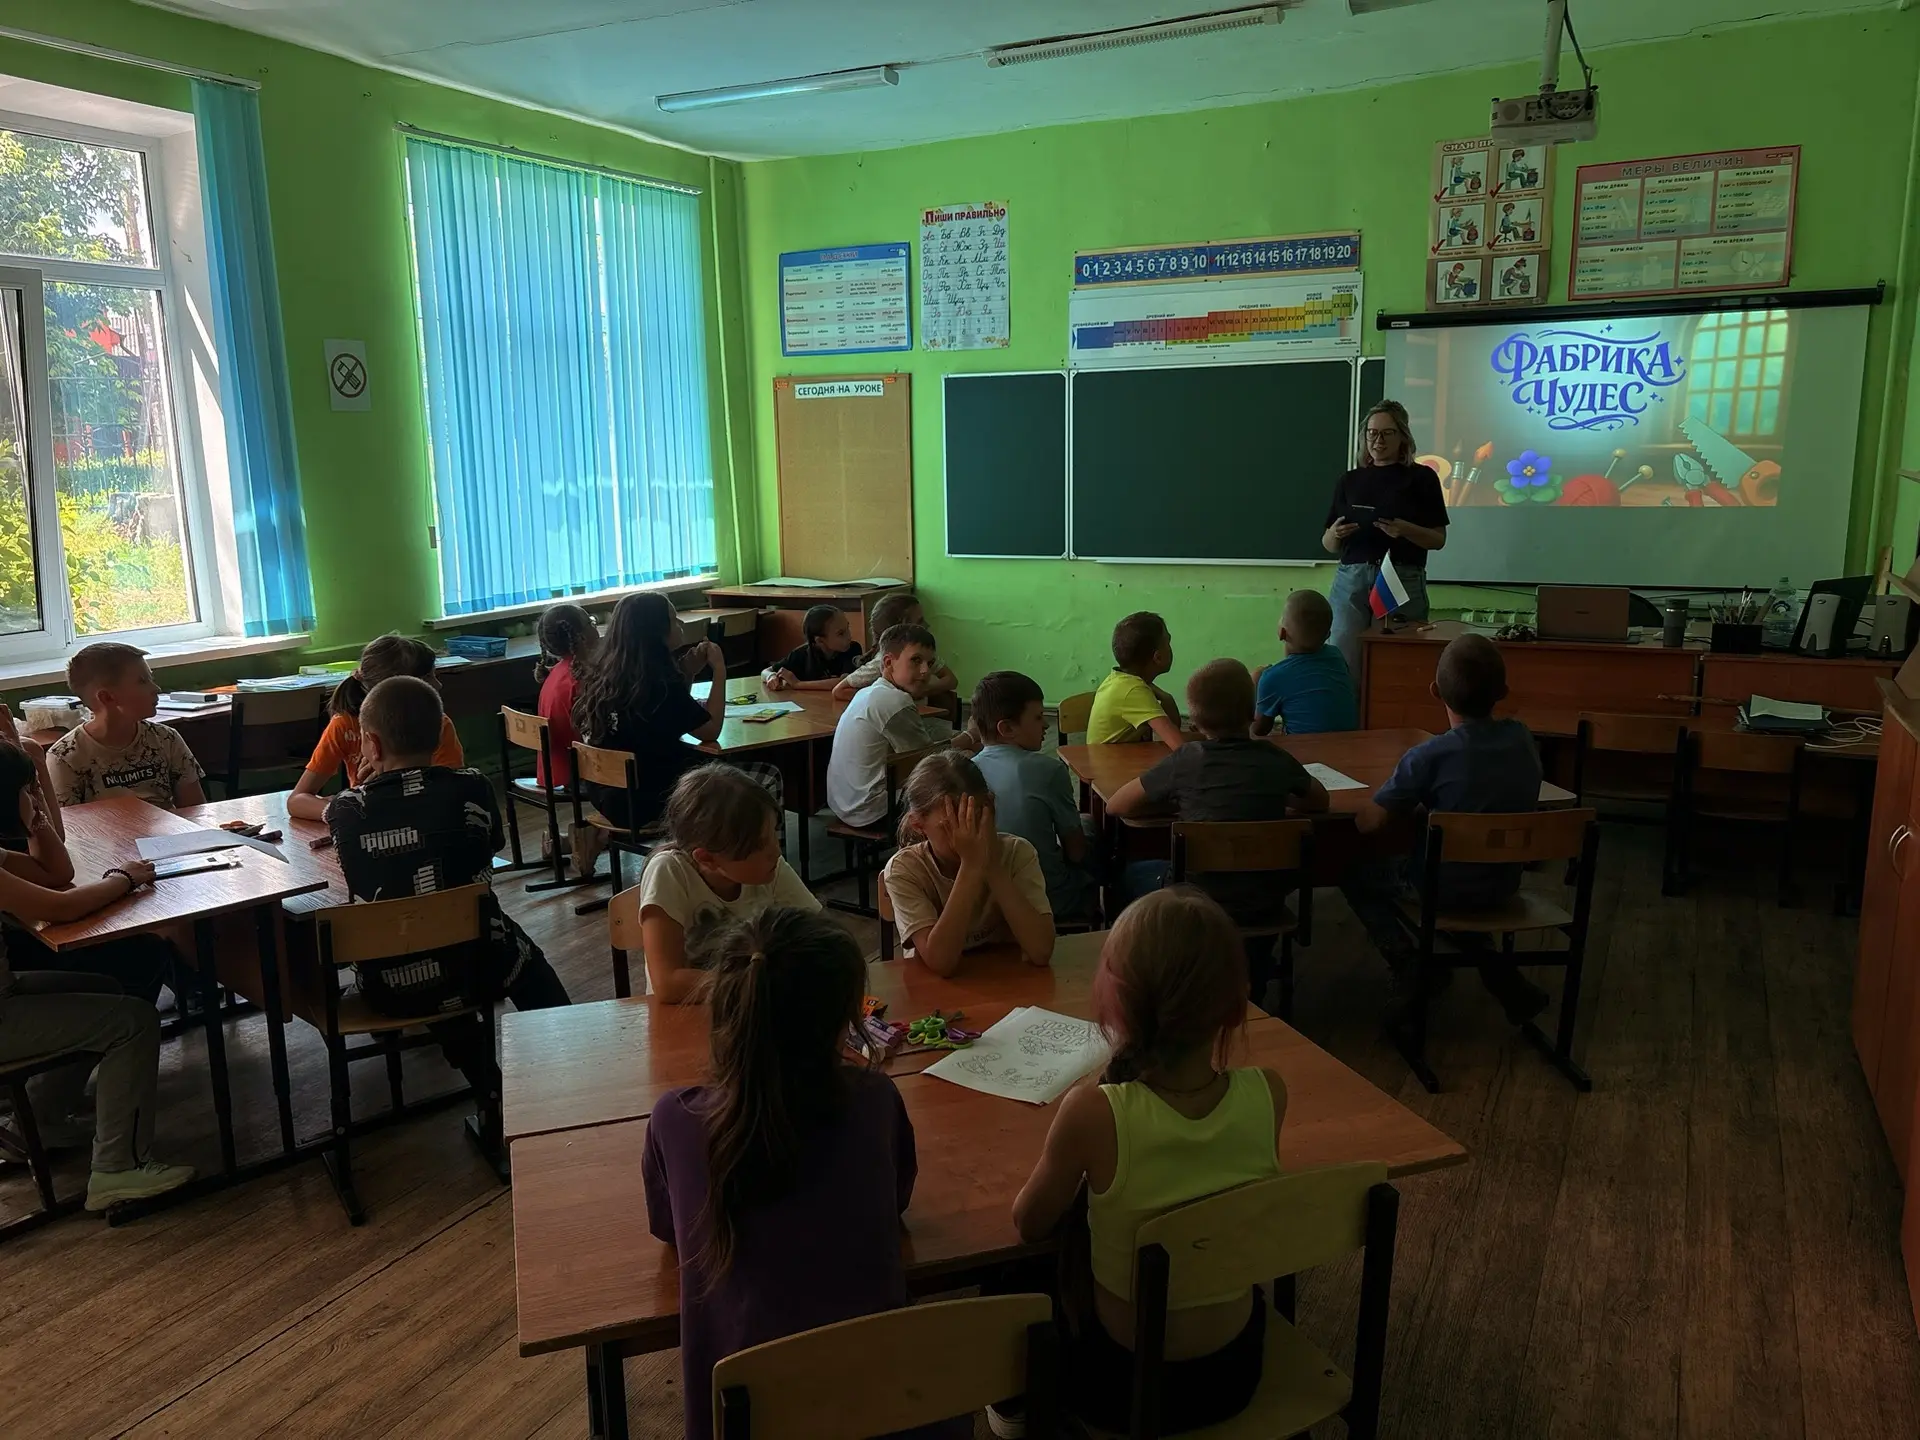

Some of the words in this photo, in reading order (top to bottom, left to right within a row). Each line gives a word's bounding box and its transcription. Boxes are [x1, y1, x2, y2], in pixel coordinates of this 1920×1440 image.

[1622, 165, 1664, 176] МЕРЫ
[1672, 157, 1744, 172] ВЕЛИЧИН
[1082, 264, 1090, 276] 0
[1093, 263, 1098, 276] 1
[1103, 262, 1110, 275] 2
[1114, 261, 1121, 274] 3
[1125, 260, 1132, 273] 4
[1136, 259, 1144, 272] 5
[1148, 258, 1155, 272] 6
[1160, 258, 1166, 271] 7
[1170, 257, 1177, 270] 8
[1181, 256, 1188, 269] 9
[1192, 254, 1207, 268] 10
[1215, 255, 1225, 266] 11
[1227, 254, 1238, 265] 12
[1240, 252, 1252, 264] 13
[1254, 251, 1266, 263] 14
[1268, 250, 1279, 262] 15
[1281, 249, 1292, 261] 16
[1295, 248, 1306, 260] 17
[1309, 247, 1320, 260] 18
[1322, 246, 1334, 258] 19
[1336, 245, 1350, 258] 20
[1490, 333, 1687, 387] ФАБРИКА
[798, 386, 835, 396] СЕГОДНЯ
[838, 385, 850, 394] НА
[854, 384, 882, 393] УРОКЕ
[1512, 377, 1648, 418] ЧУДЕС
[361, 827, 420, 853] PUMA
[382, 960, 441, 988] PUMA
